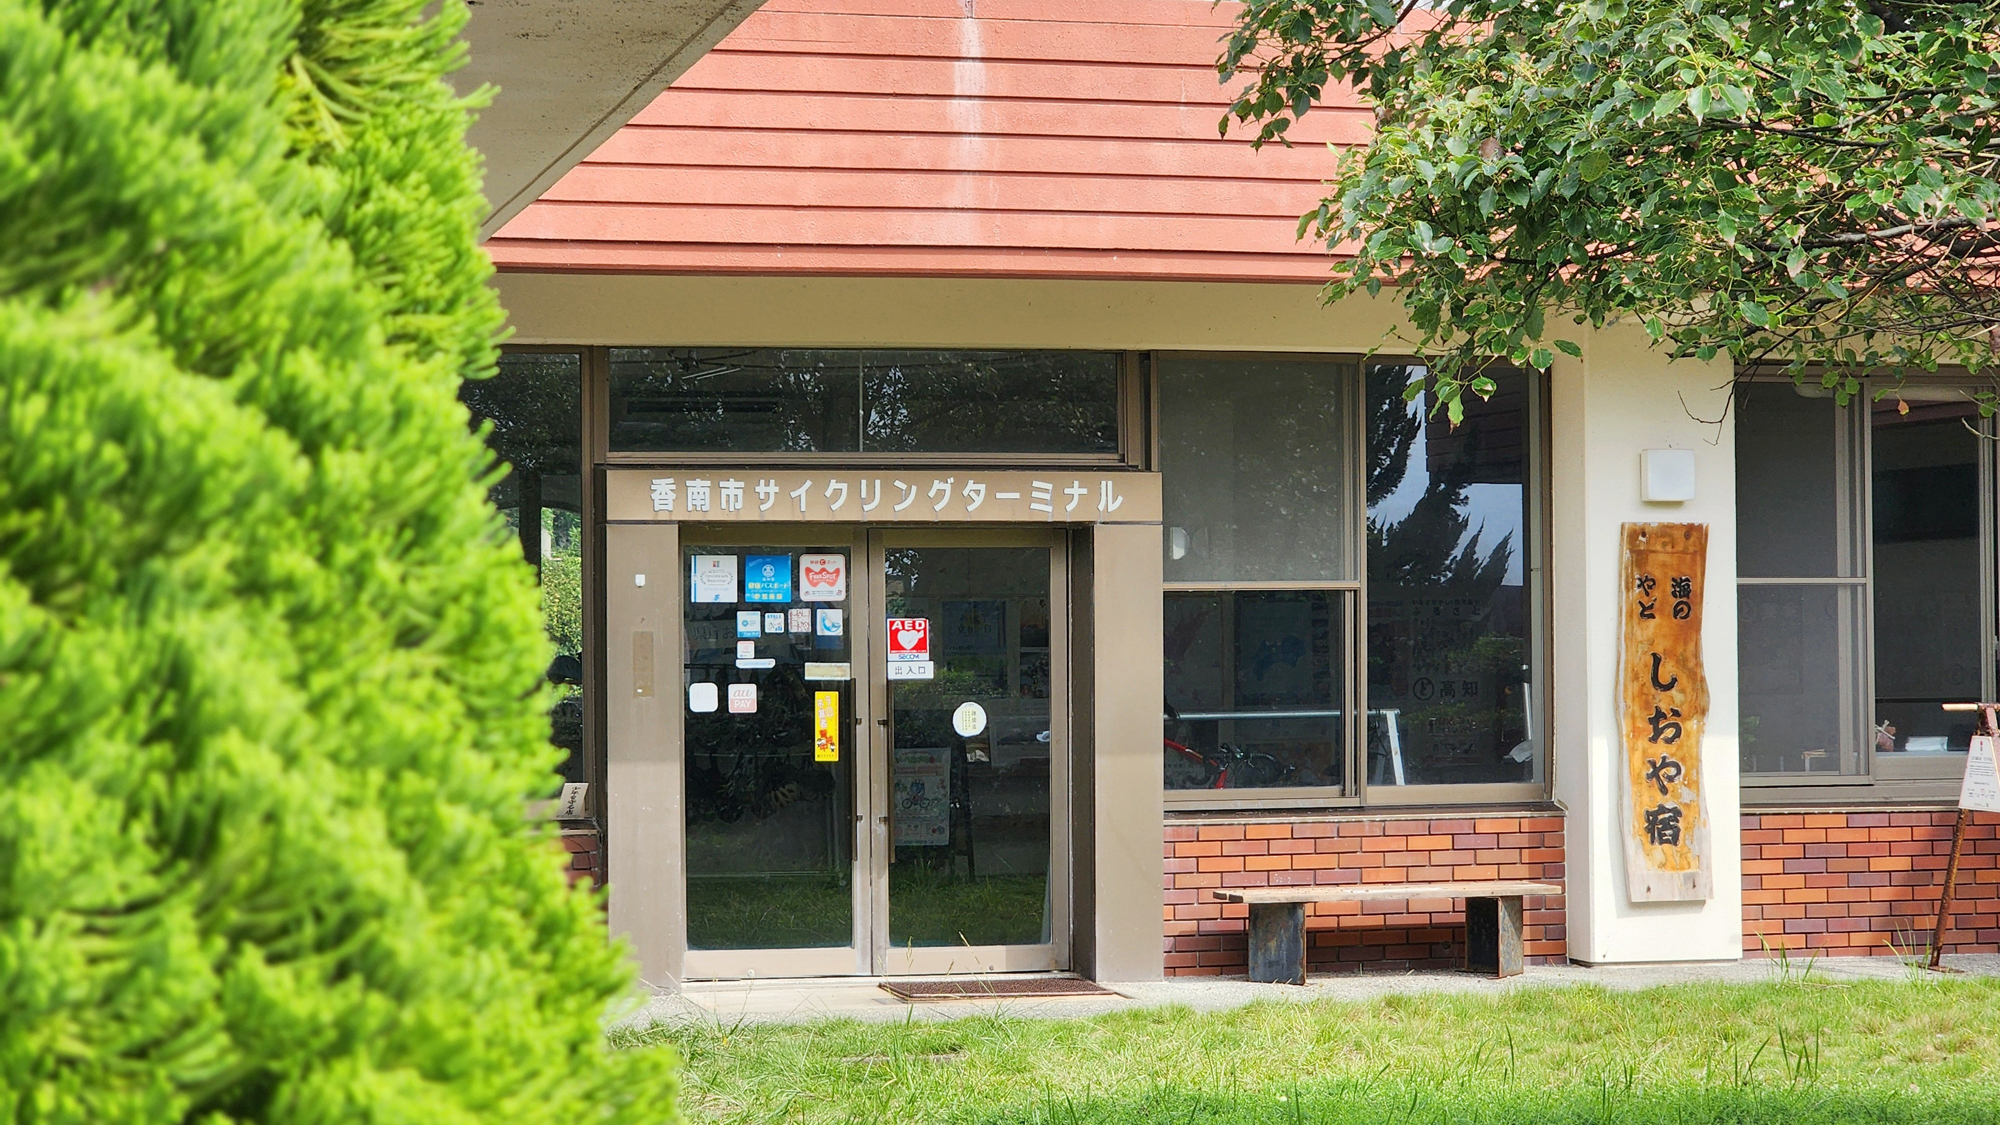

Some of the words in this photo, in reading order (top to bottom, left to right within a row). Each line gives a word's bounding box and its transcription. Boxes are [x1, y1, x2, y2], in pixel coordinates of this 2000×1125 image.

[650, 477, 1124, 513] 香南市サイクリングターミナル
[1635, 574, 1657, 620] やど
[1670, 575, 1692, 620] 海の
[891, 620, 925, 630] AED
[894, 666, 926, 675] 出入口
[733, 689, 753, 698] au
[734, 699, 752, 708] PAY
[1643, 652, 1684, 847] しおや宿
